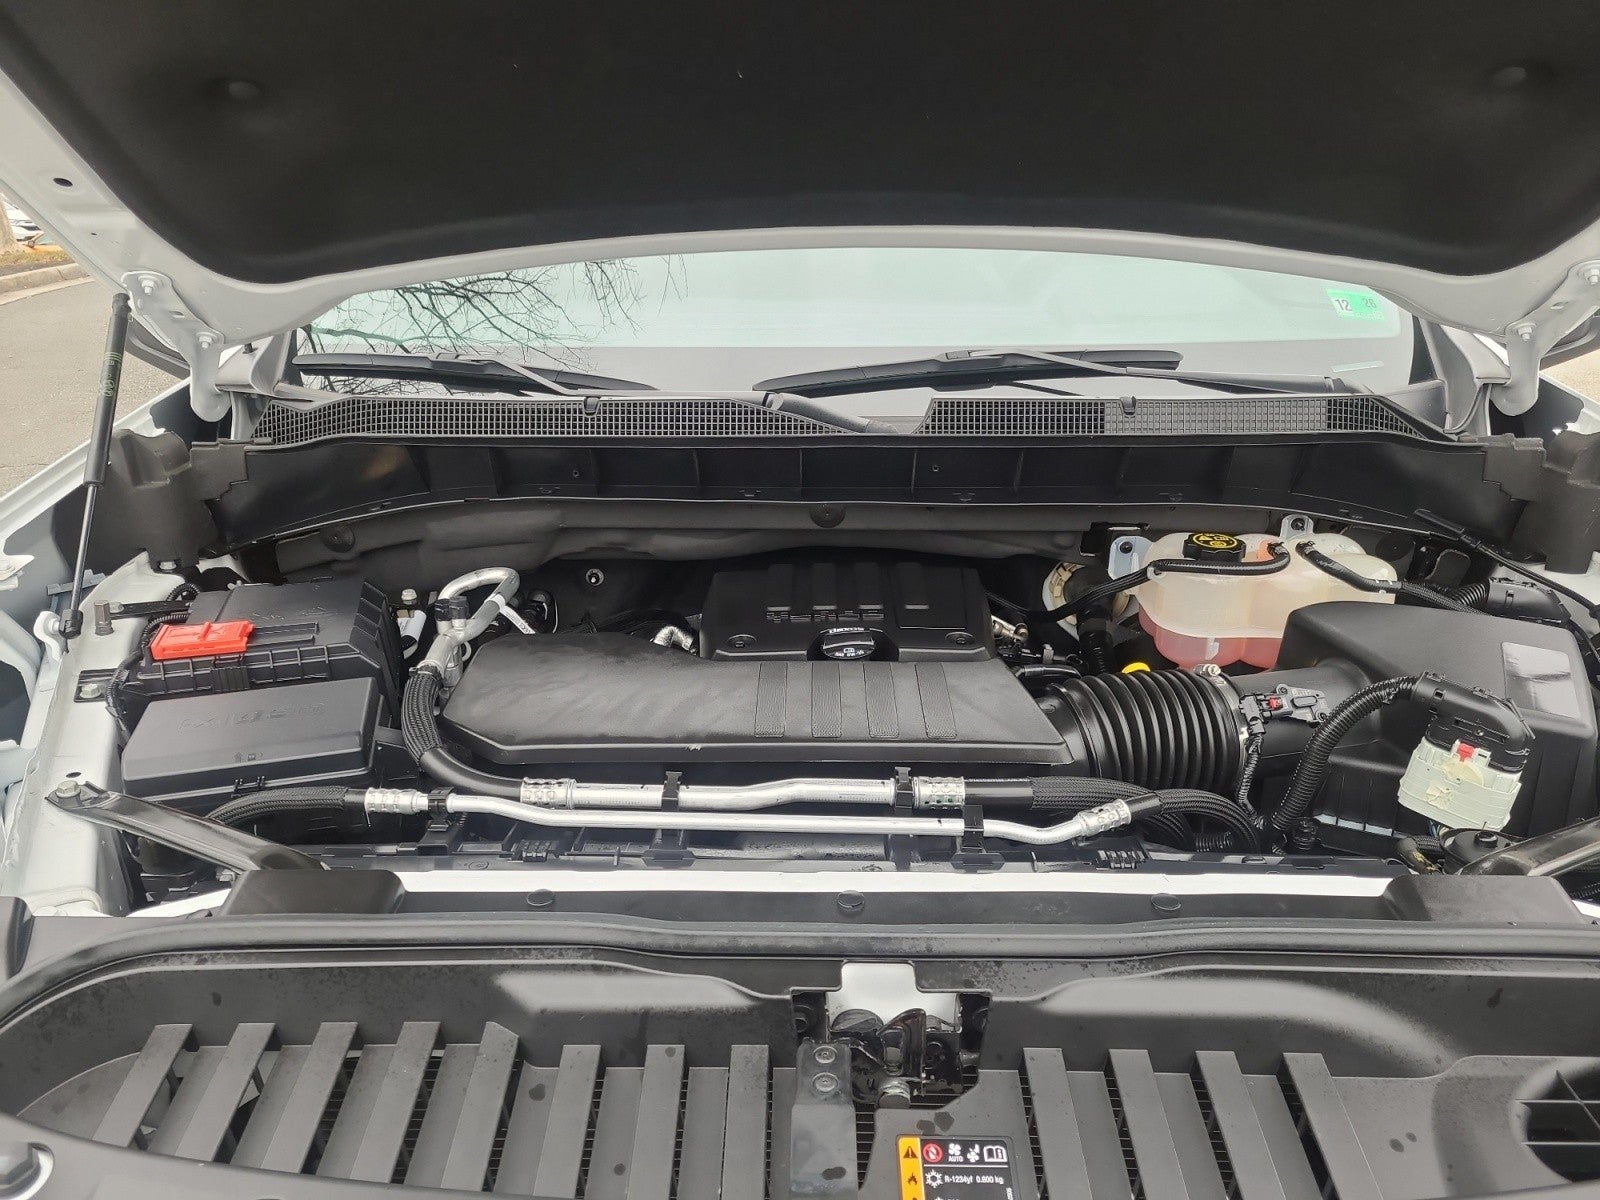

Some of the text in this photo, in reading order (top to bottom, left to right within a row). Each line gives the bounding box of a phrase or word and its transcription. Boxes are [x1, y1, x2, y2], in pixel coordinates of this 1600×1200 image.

[1335, 299, 1352, 311] 12
[944, 1175, 973, 1184] R-1234yf
[994, 1175, 1004, 1185] kg
